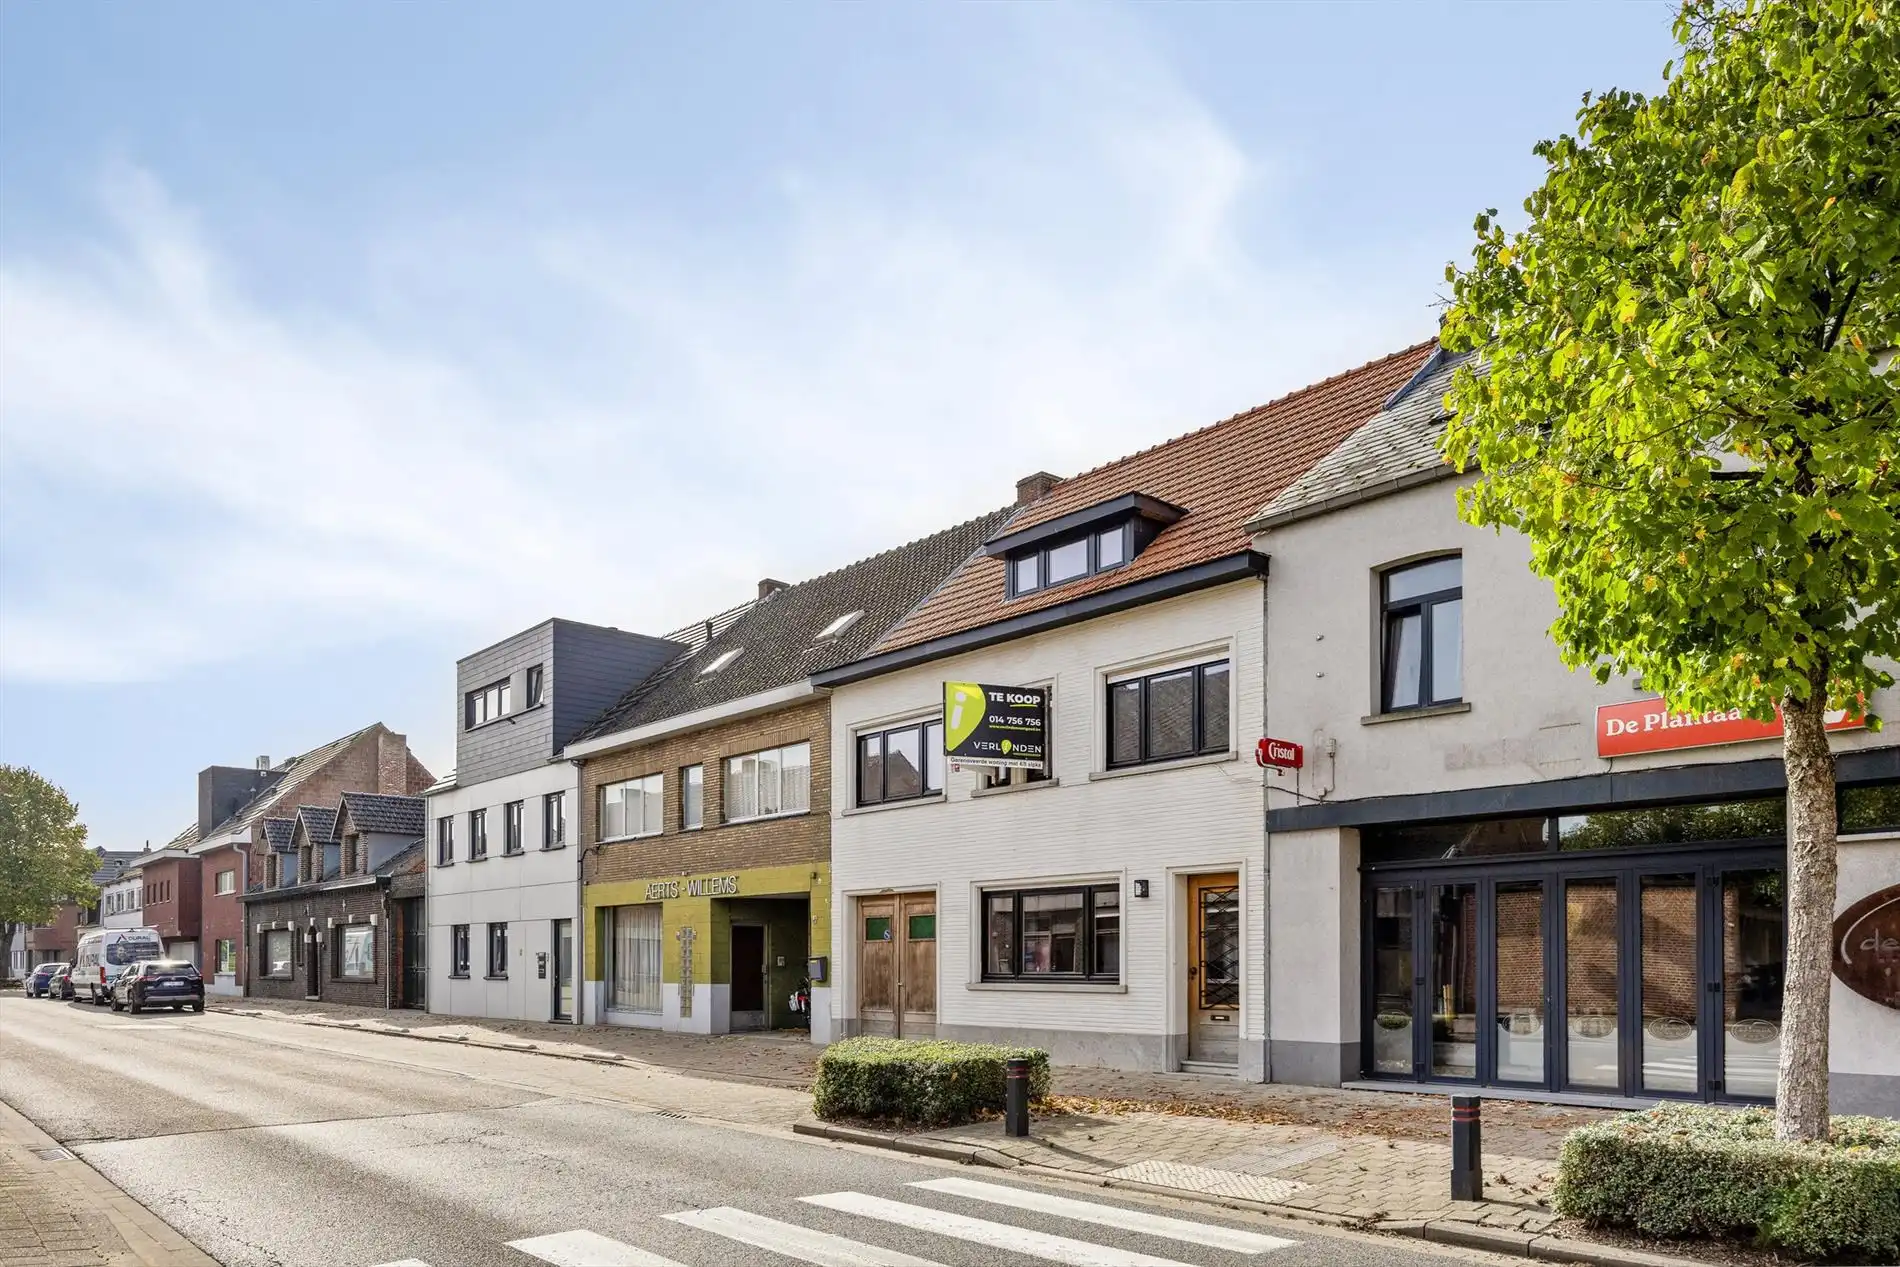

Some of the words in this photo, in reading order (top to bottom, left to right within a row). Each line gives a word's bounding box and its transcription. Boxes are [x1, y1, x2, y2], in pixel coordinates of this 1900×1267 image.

[989, 692, 1004, 702] TE
[1006, 694, 1040, 704] KOOP
[989, 715, 1004, 723] 014
[1006, 716, 1023, 725] 756
[1024, 718, 1041, 726] 756
[1606, 719, 1639, 736] De
[1643, 707, 1743, 731] Plantaa
[1268, 742, 1295, 761] Cristal
[645, 880, 680, 900] AERTS
[687, 875, 739, 897] WILLEMS
